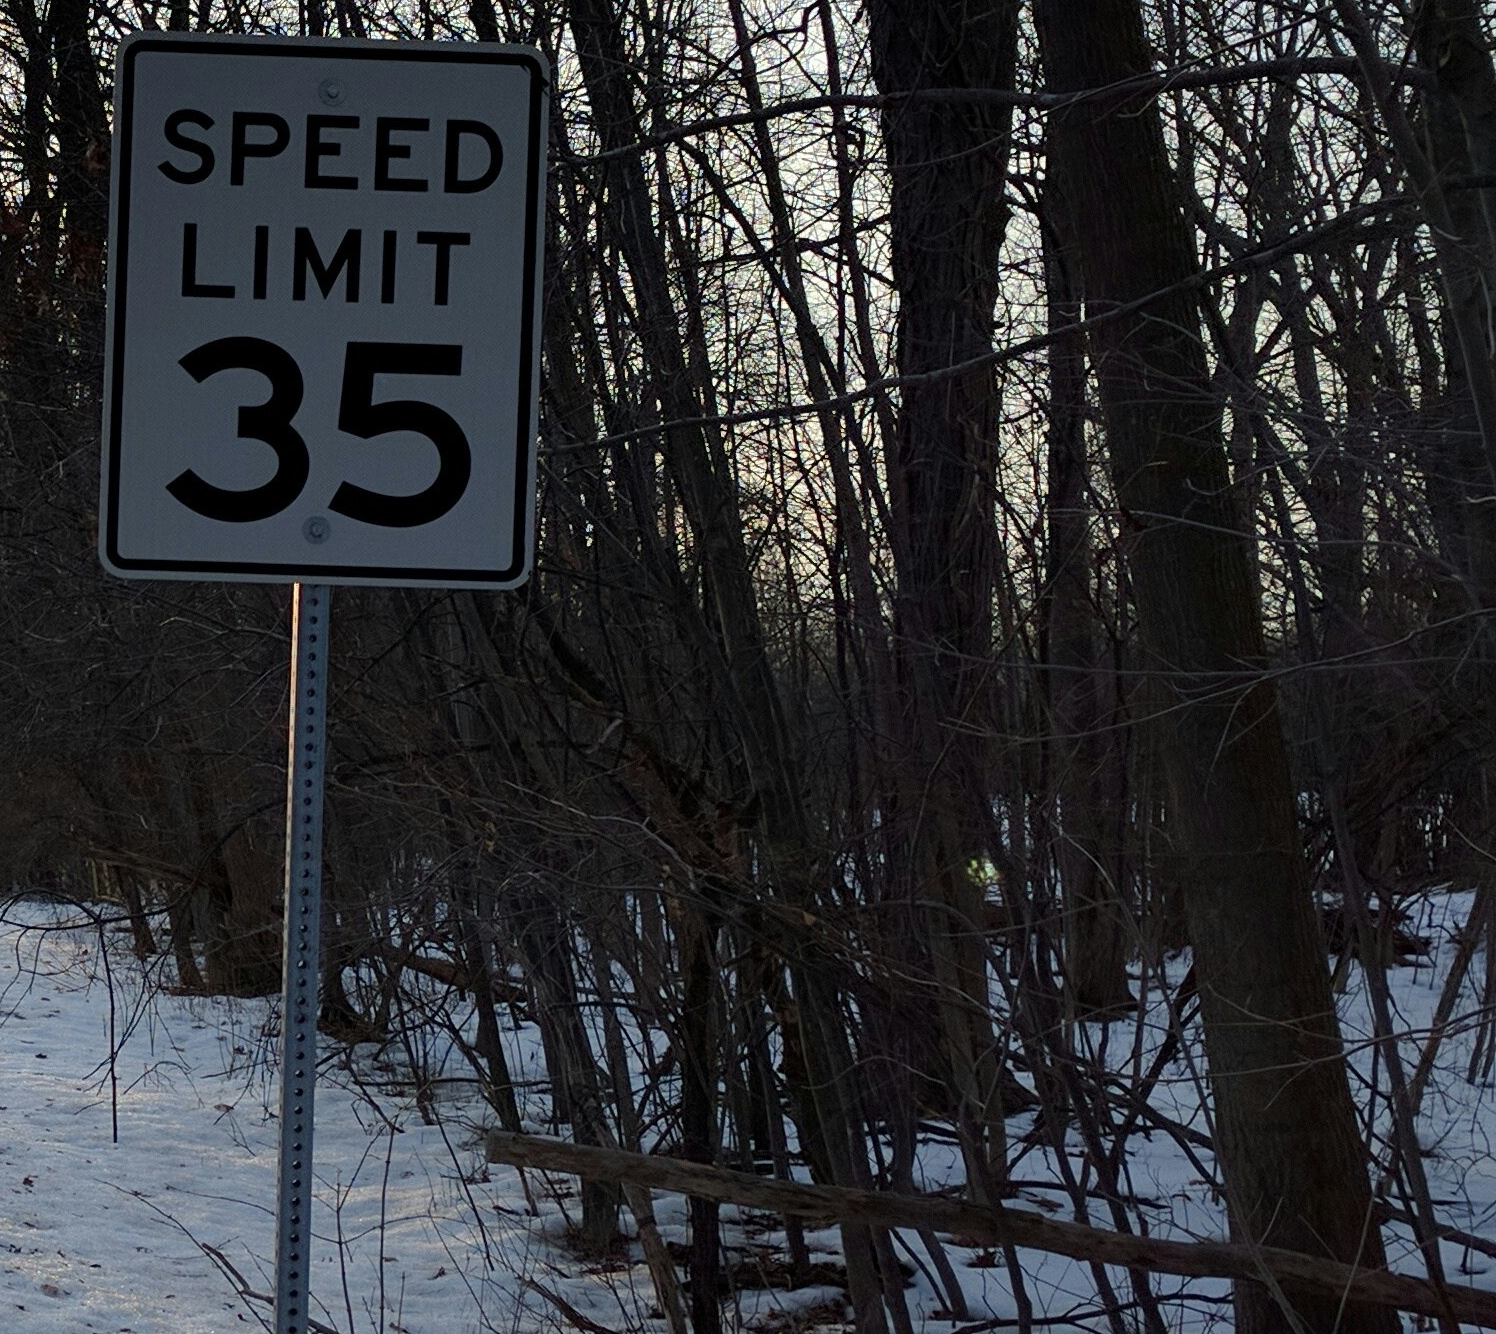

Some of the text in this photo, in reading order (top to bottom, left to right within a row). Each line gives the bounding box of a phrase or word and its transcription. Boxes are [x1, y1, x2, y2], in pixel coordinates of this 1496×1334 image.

[157, 108, 504, 194] SPEED
[181, 222, 471, 306] LIMIT
[165, 336, 472, 528] 35
